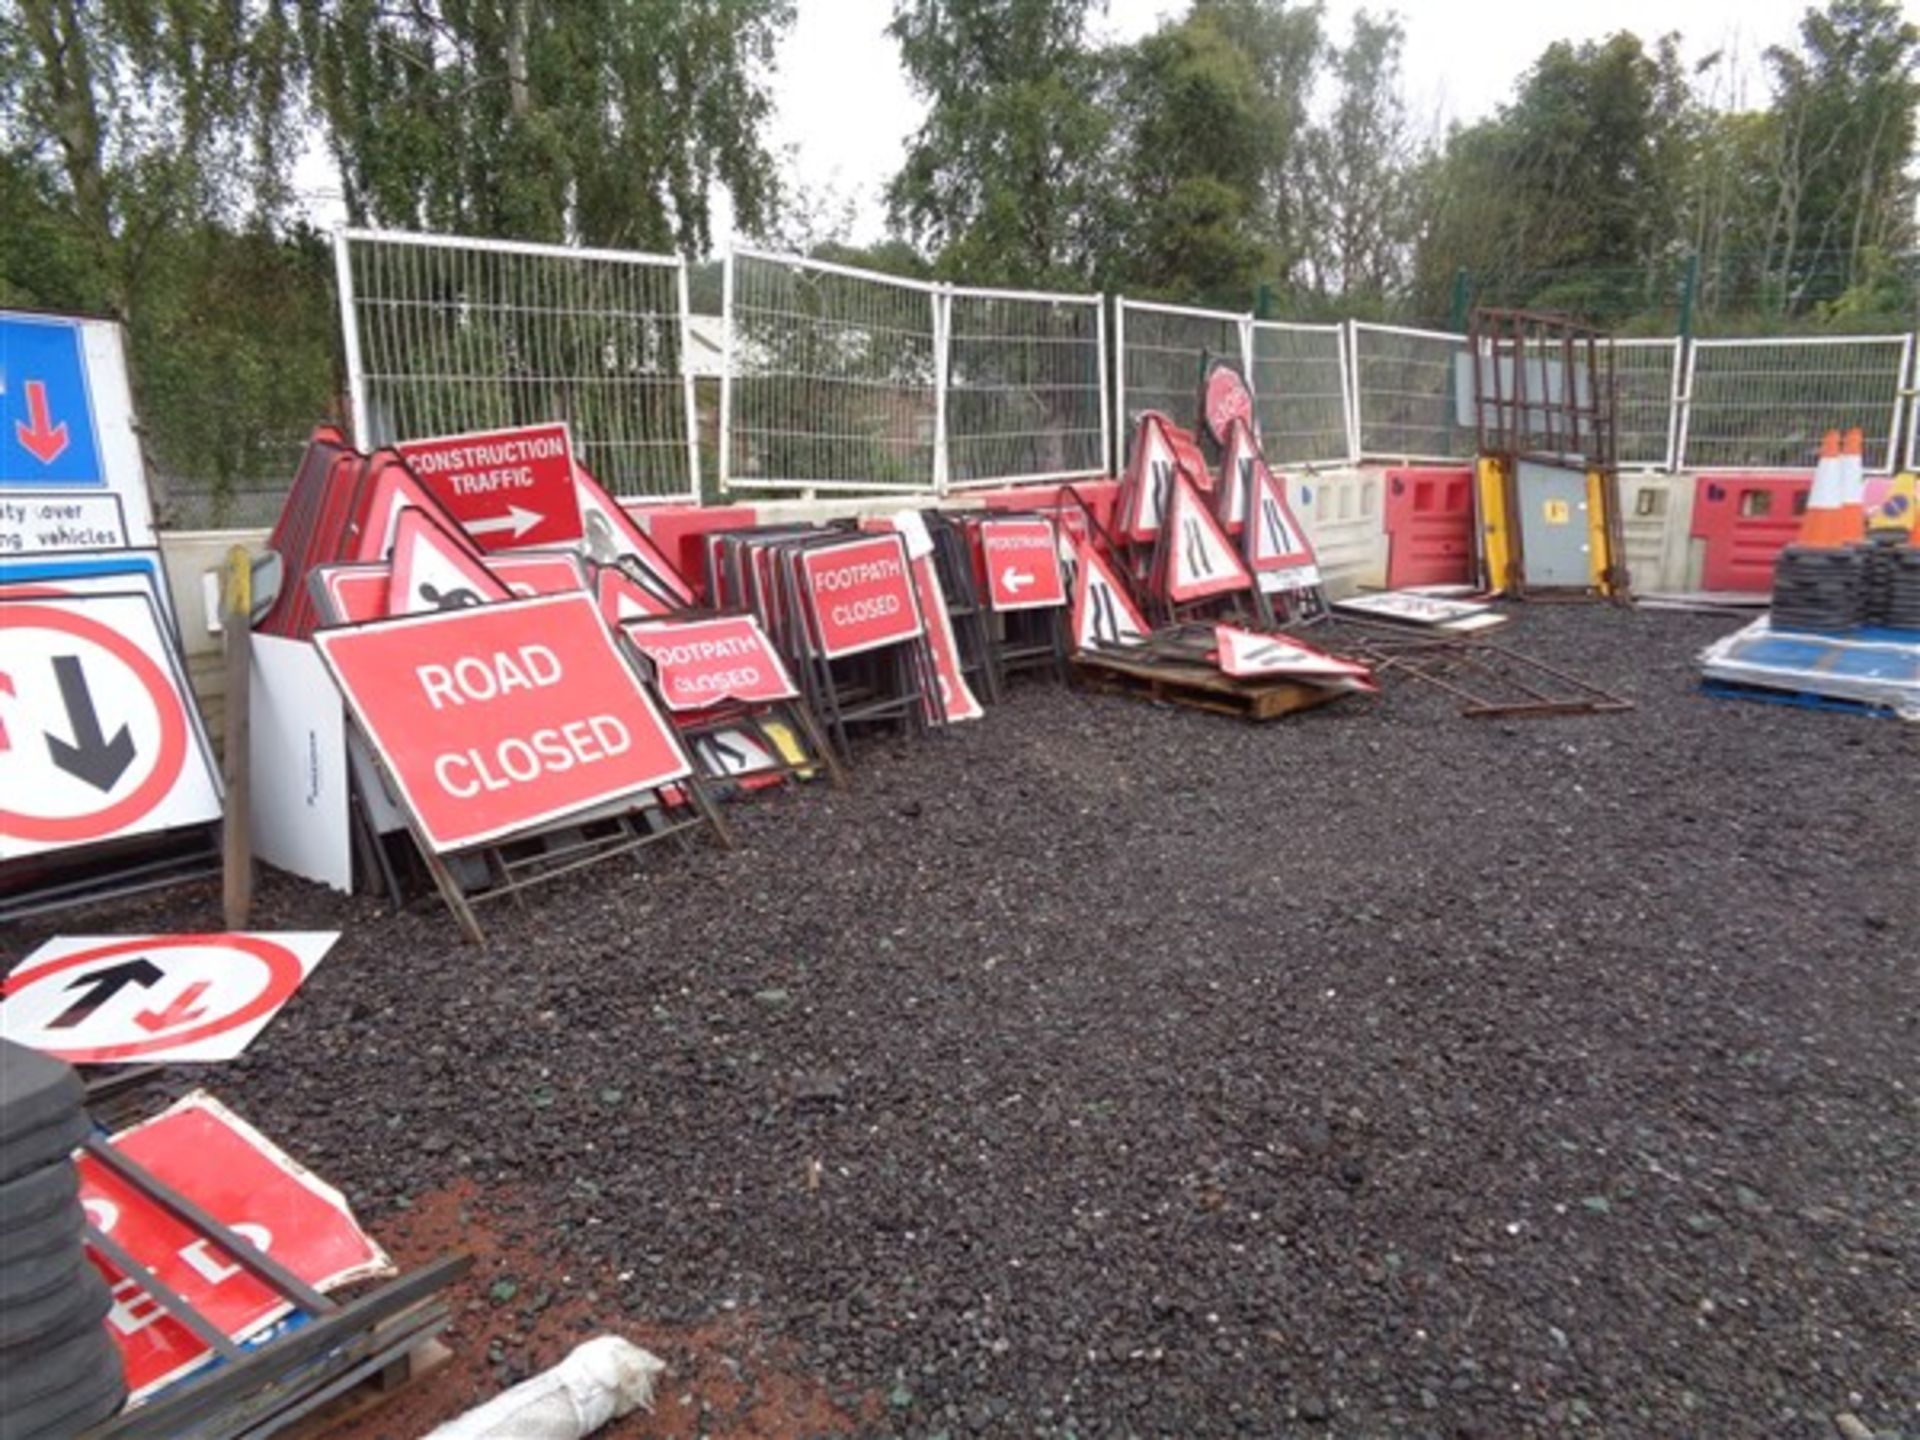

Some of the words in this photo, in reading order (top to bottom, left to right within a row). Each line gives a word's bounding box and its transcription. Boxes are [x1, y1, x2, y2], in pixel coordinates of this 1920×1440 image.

[406, 437, 564, 474] CONSTRUCTION
[450, 466, 534, 495] TRAFFIC
[38, 525, 117, 545] vehicles
[814, 559, 901, 592] FOOTPATH
[831, 594, 901, 626] CLOSED
[416, 644, 562, 709] ROAD
[673, 667, 759, 692] CLOSED
[434, 715, 631, 798] CLOSED
